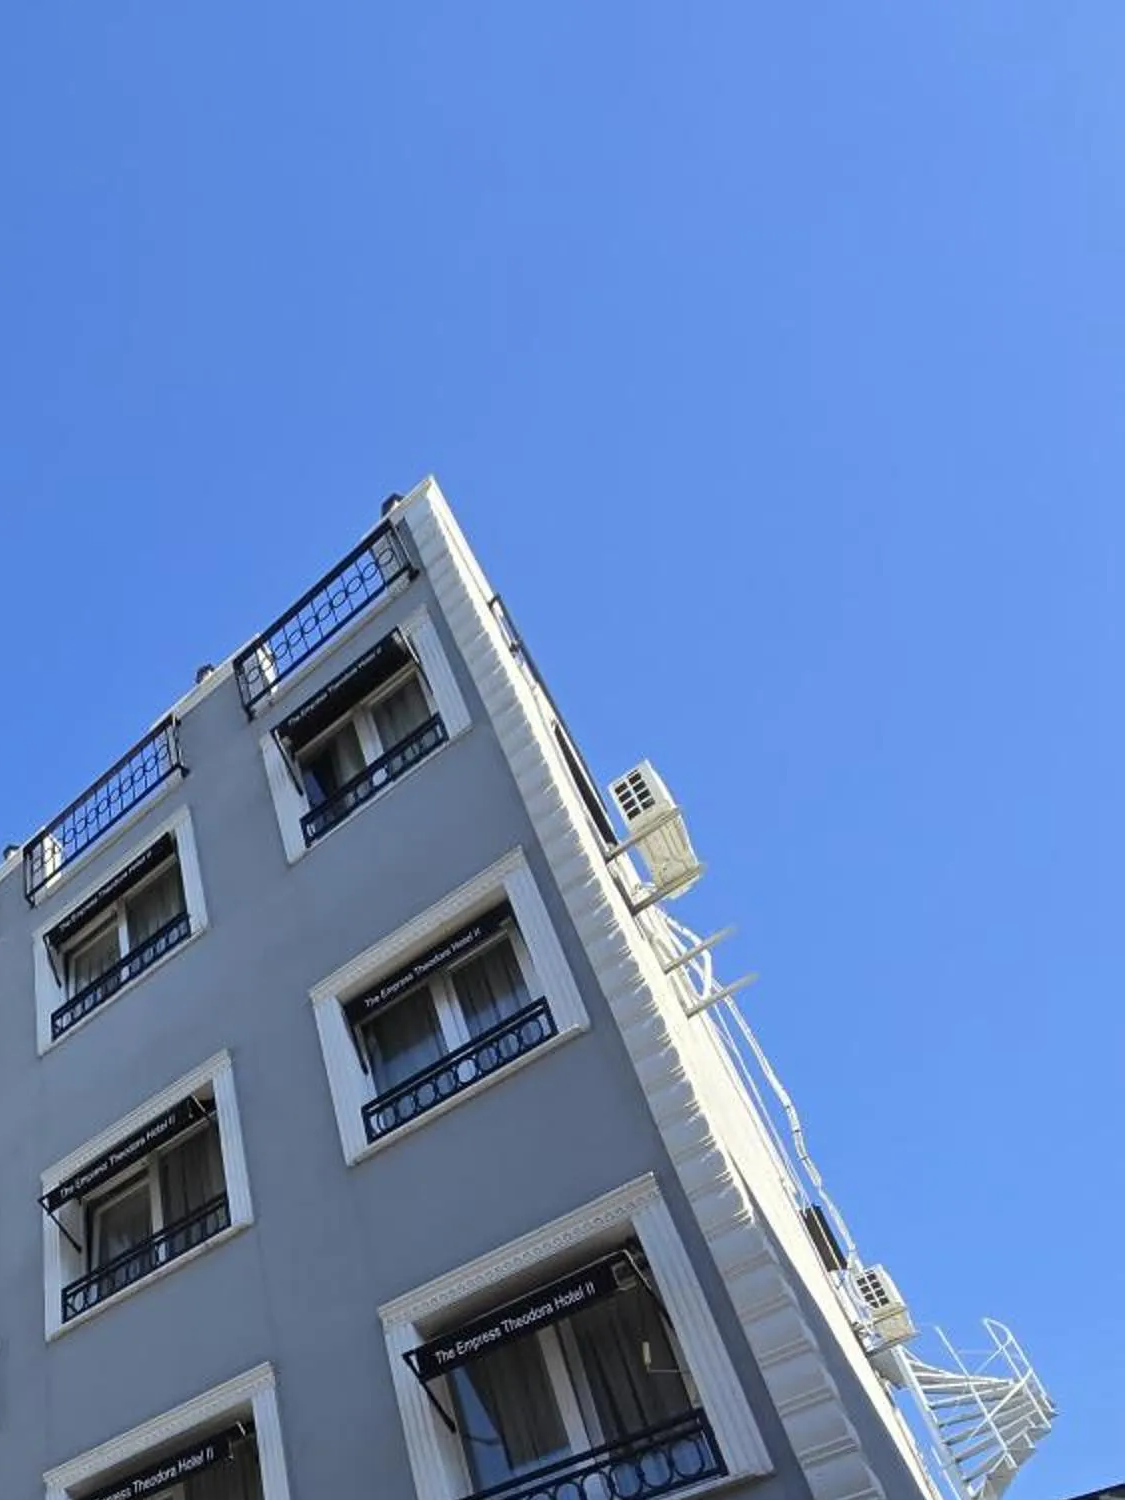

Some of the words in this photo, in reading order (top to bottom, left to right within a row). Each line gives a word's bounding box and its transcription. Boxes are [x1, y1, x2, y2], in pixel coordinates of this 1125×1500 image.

[434, 1349, 456, 1365] The
[456, 1326, 502, 1356] Empress
[500, 1303, 554, 1333] Theodora
[553, 1286, 584, 1310] Hotel
[132, 1466, 176, 1495] Theodora
[177, 1450, 205, 1473] Hotel
